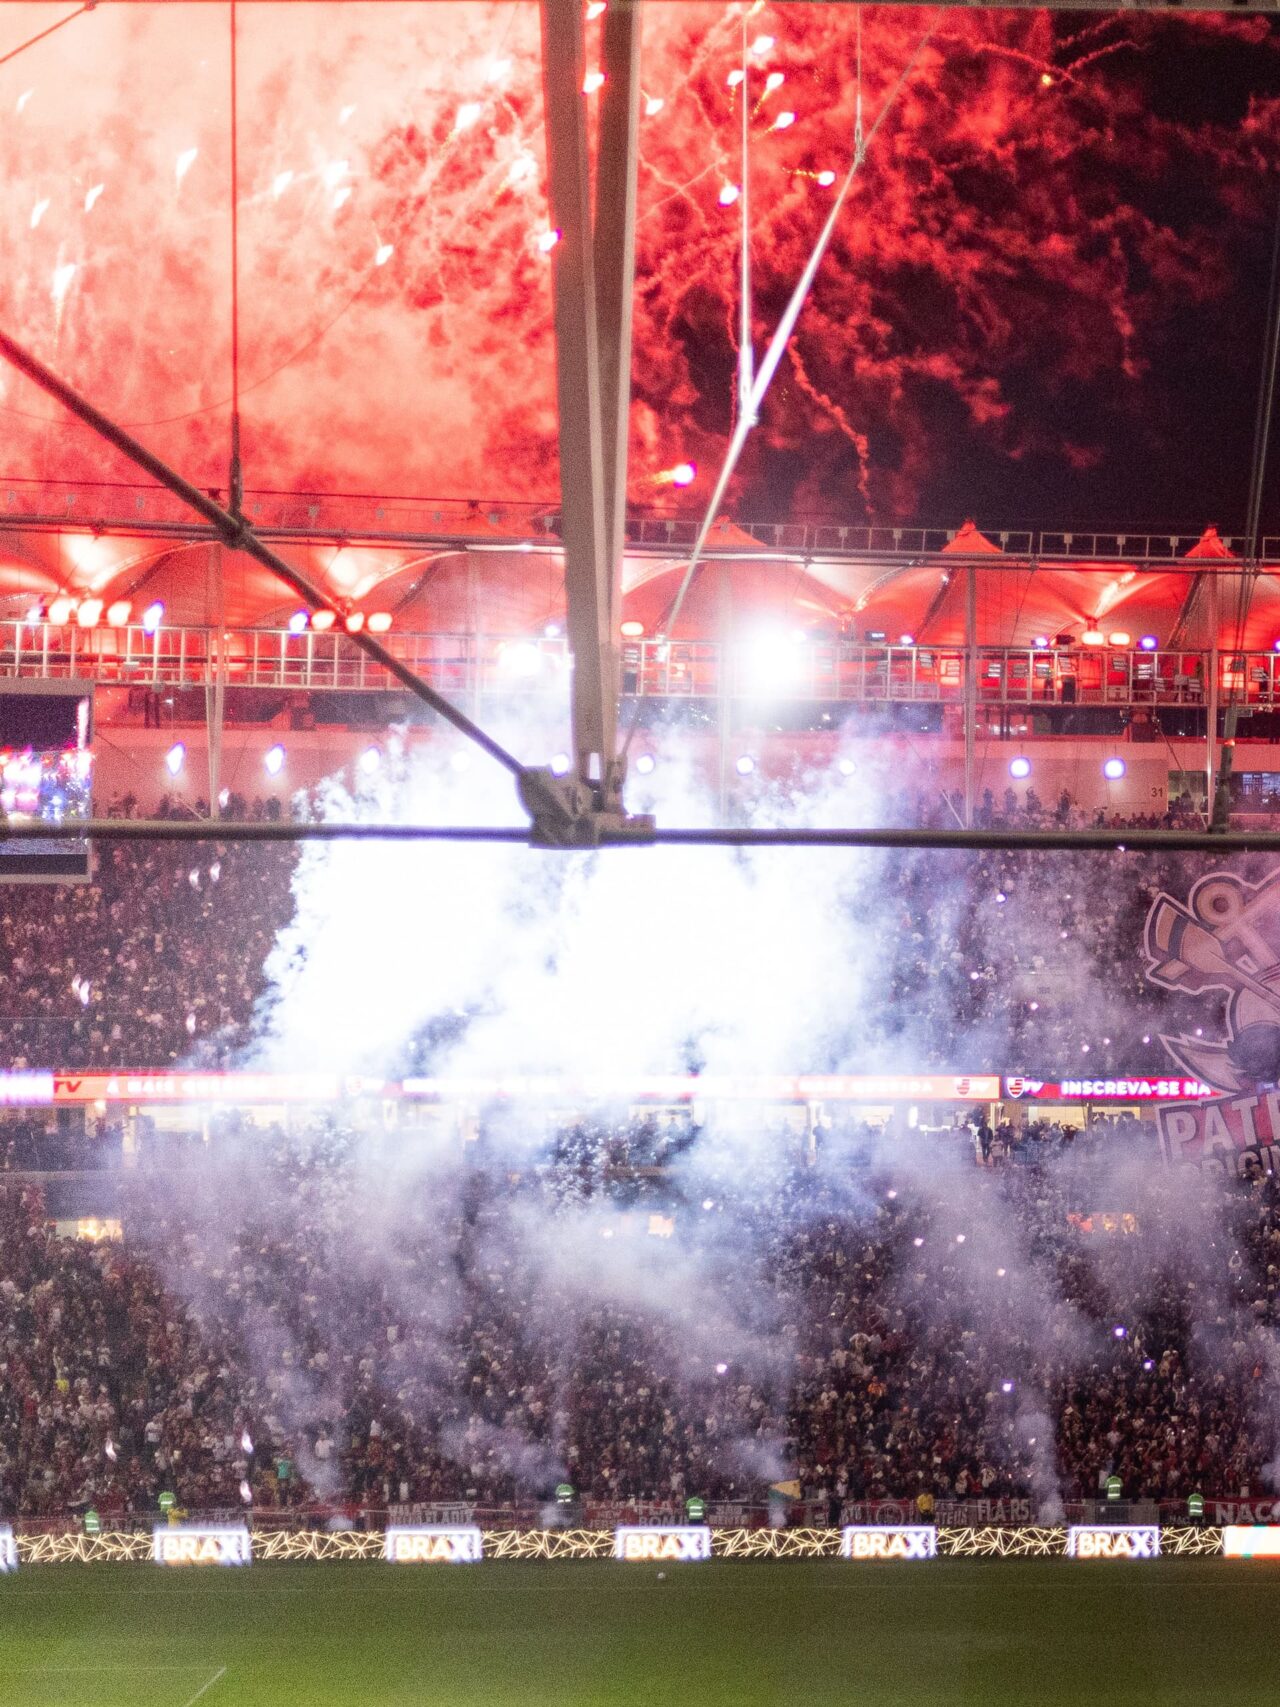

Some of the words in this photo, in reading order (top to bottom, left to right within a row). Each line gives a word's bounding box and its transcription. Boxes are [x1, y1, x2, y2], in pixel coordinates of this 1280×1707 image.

[1151, 786, 1163, 798] 31
[1060, 1080, 1180, 1097] INSCREVA-SE
[163, 1536, 241, 1561] BRAX
[396, 1534, 472, 1560] BRAX
[625, 1533, 699, 1558] BRAX
[853, 1532, 926, 1557] BRAX
[1078, 1532, 1151, 1556] BRAX
